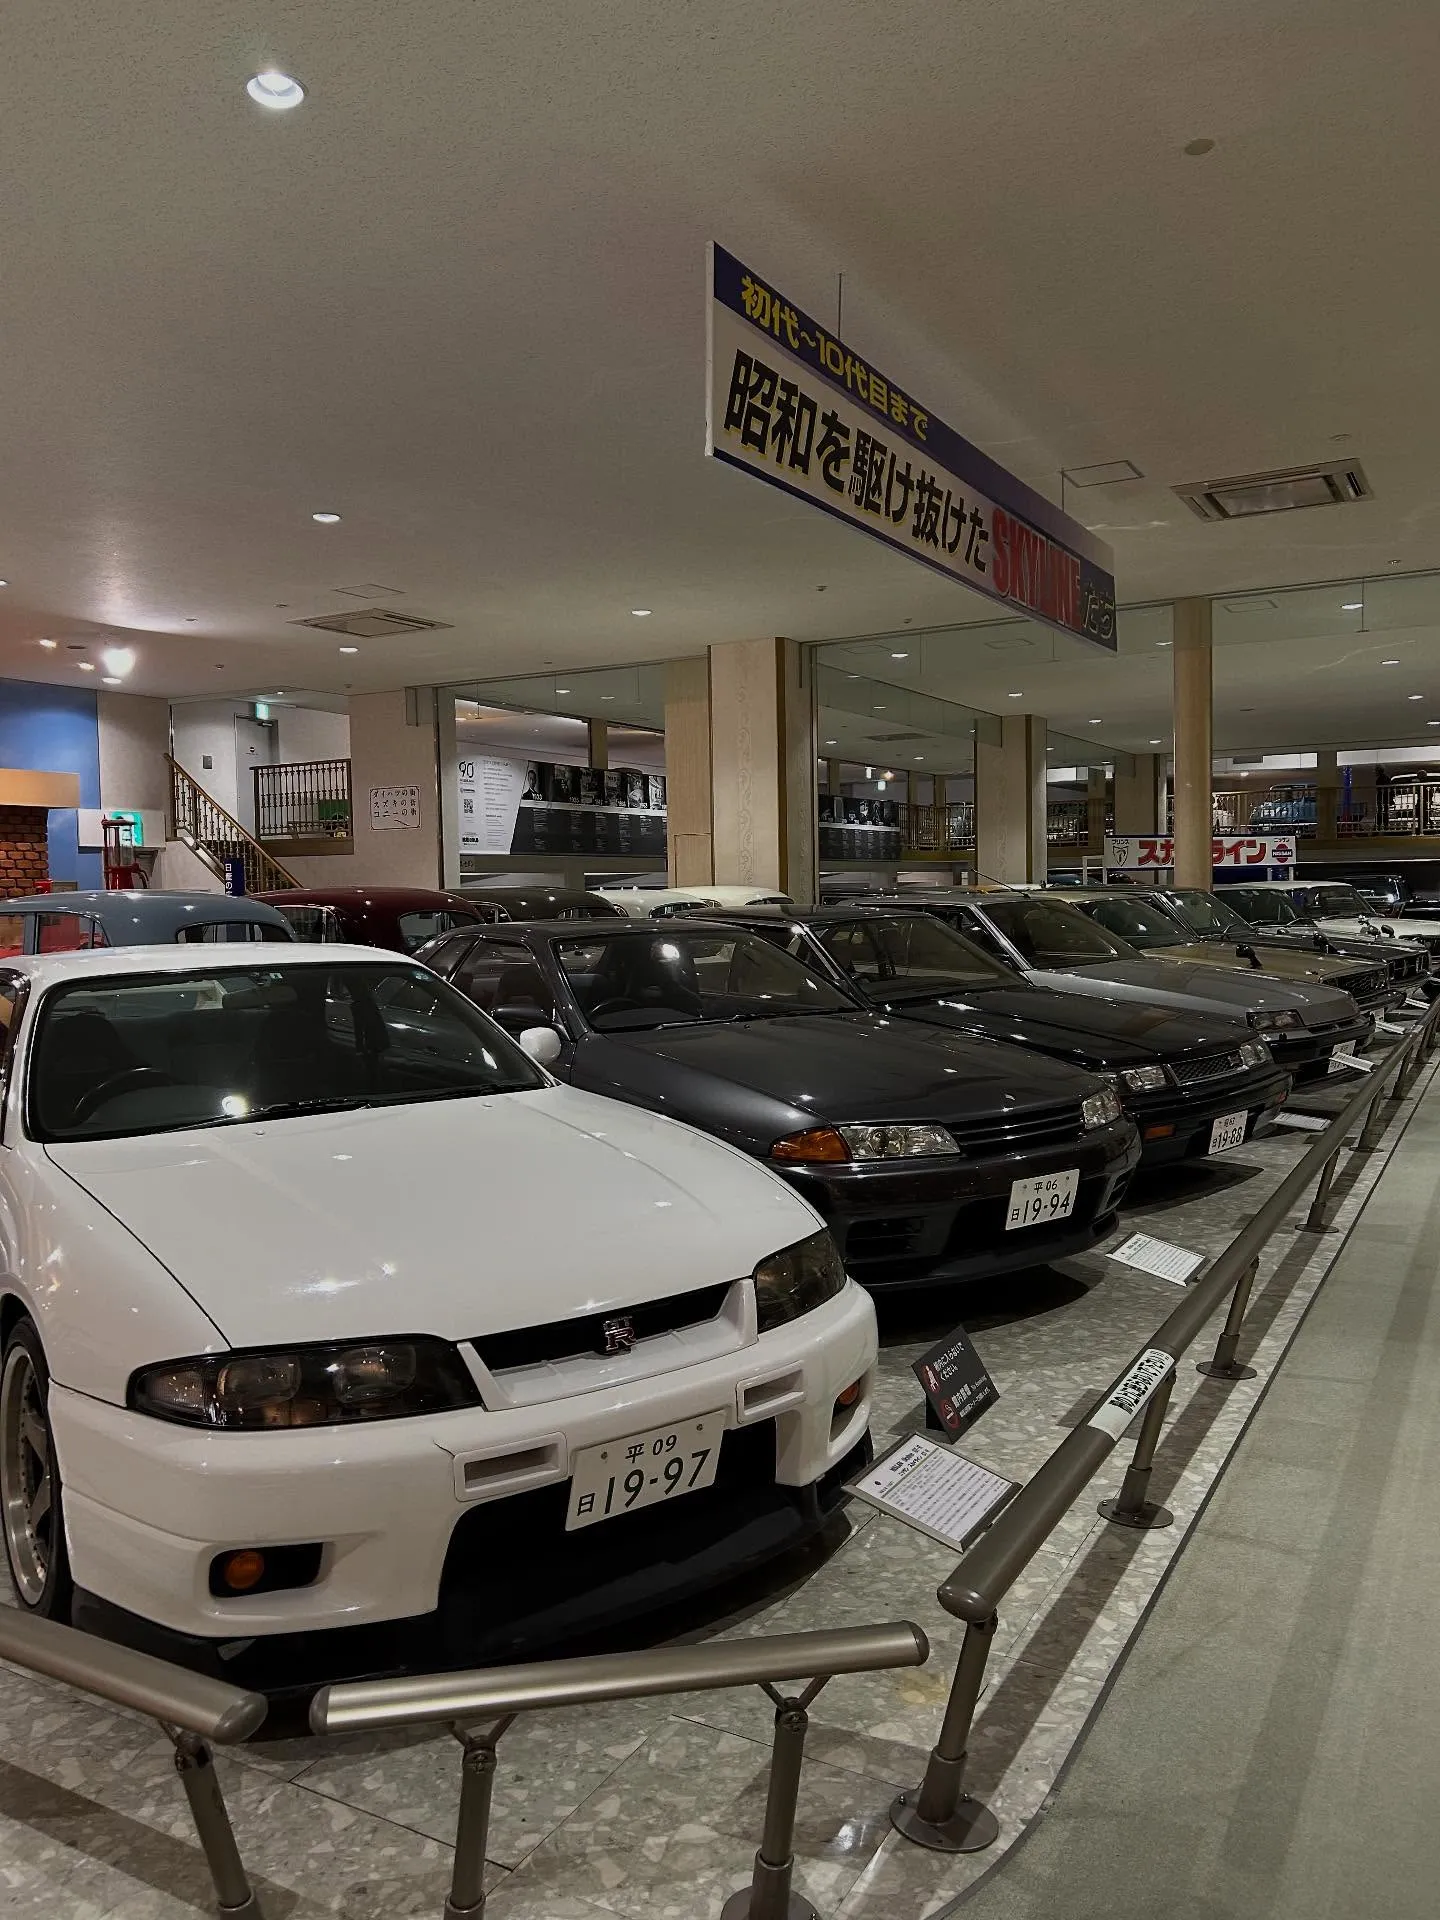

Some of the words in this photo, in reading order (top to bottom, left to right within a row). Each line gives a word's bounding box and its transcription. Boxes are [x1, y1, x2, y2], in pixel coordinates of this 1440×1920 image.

[1271, 849, 1293, 858] NISSAN
[1022, 1190, 1071, 1224] 19-94
[603, 1448, 712, 1515] 19-97
